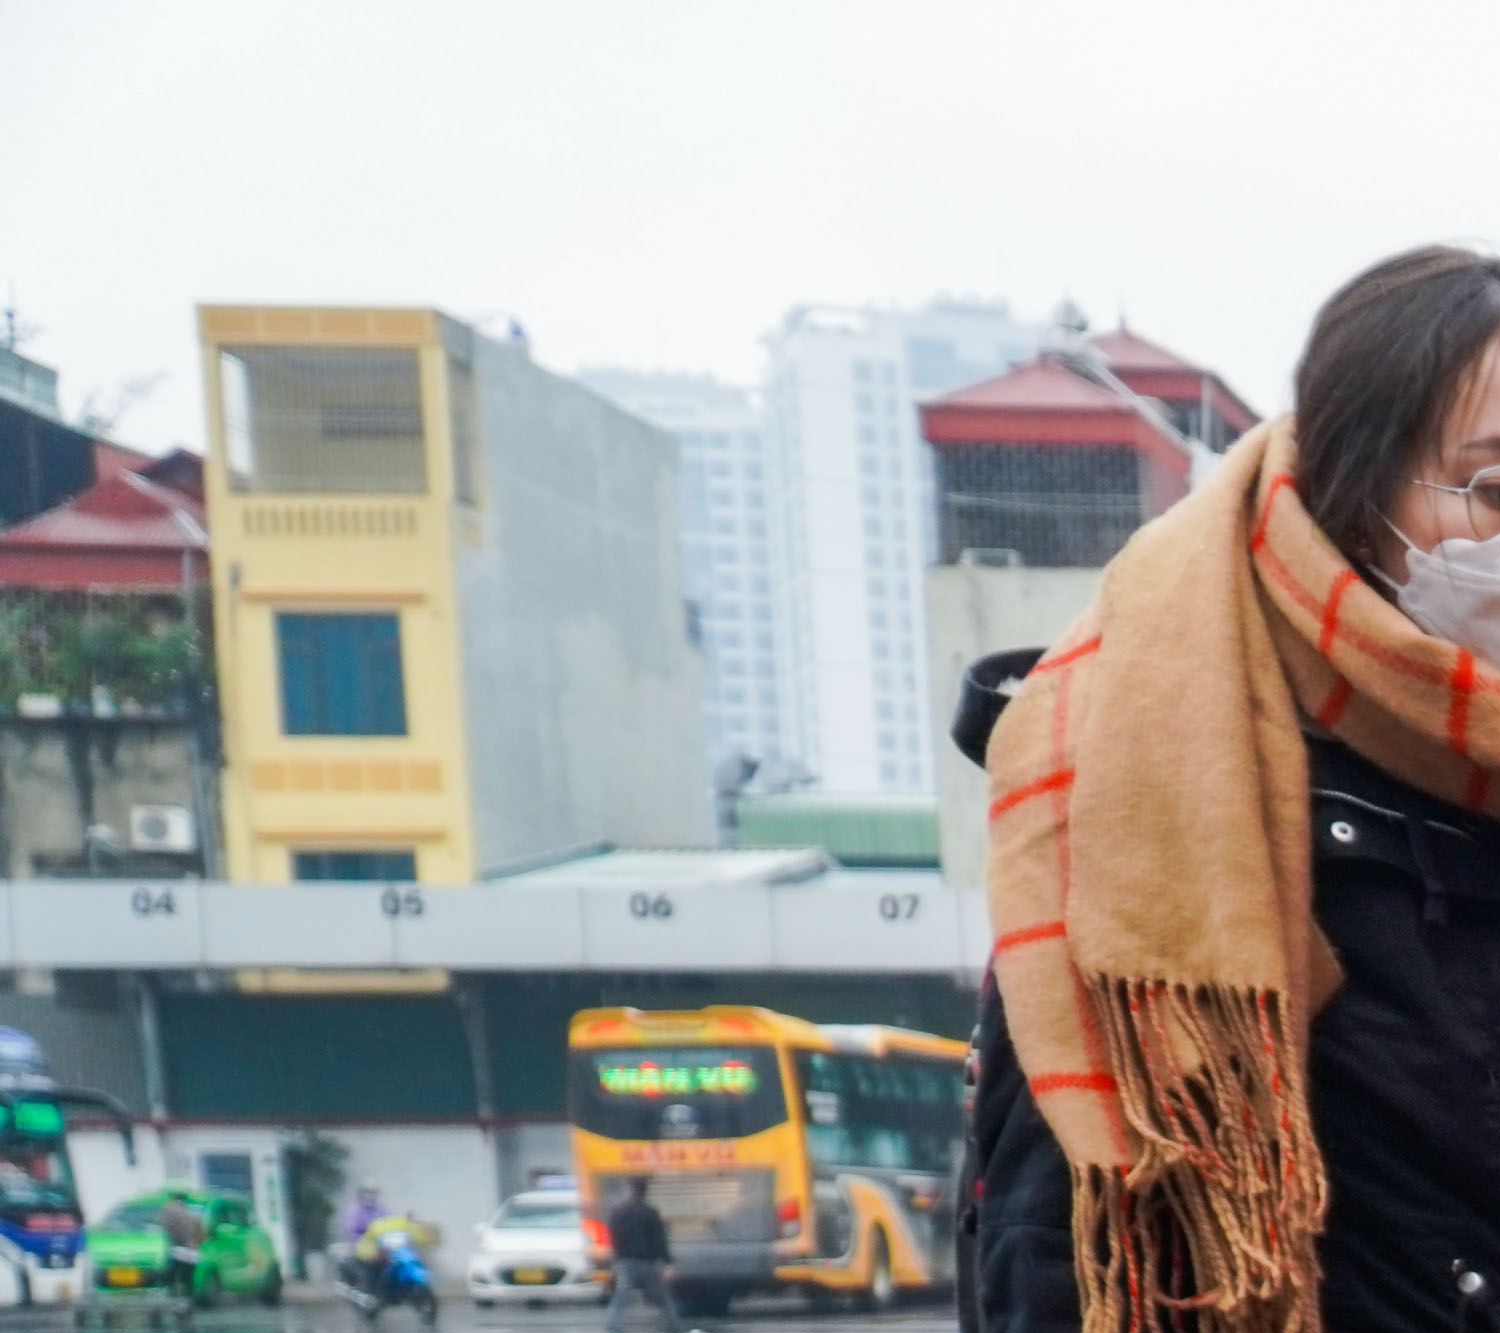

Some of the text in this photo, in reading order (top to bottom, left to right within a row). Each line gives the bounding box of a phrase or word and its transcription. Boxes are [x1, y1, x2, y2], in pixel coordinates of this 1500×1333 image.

[132, 891, 176, 918] 04
[380, 891, 424, 918] 05
[629, 893, 673, 919] 06
[879, 893, 922, 920] 07
